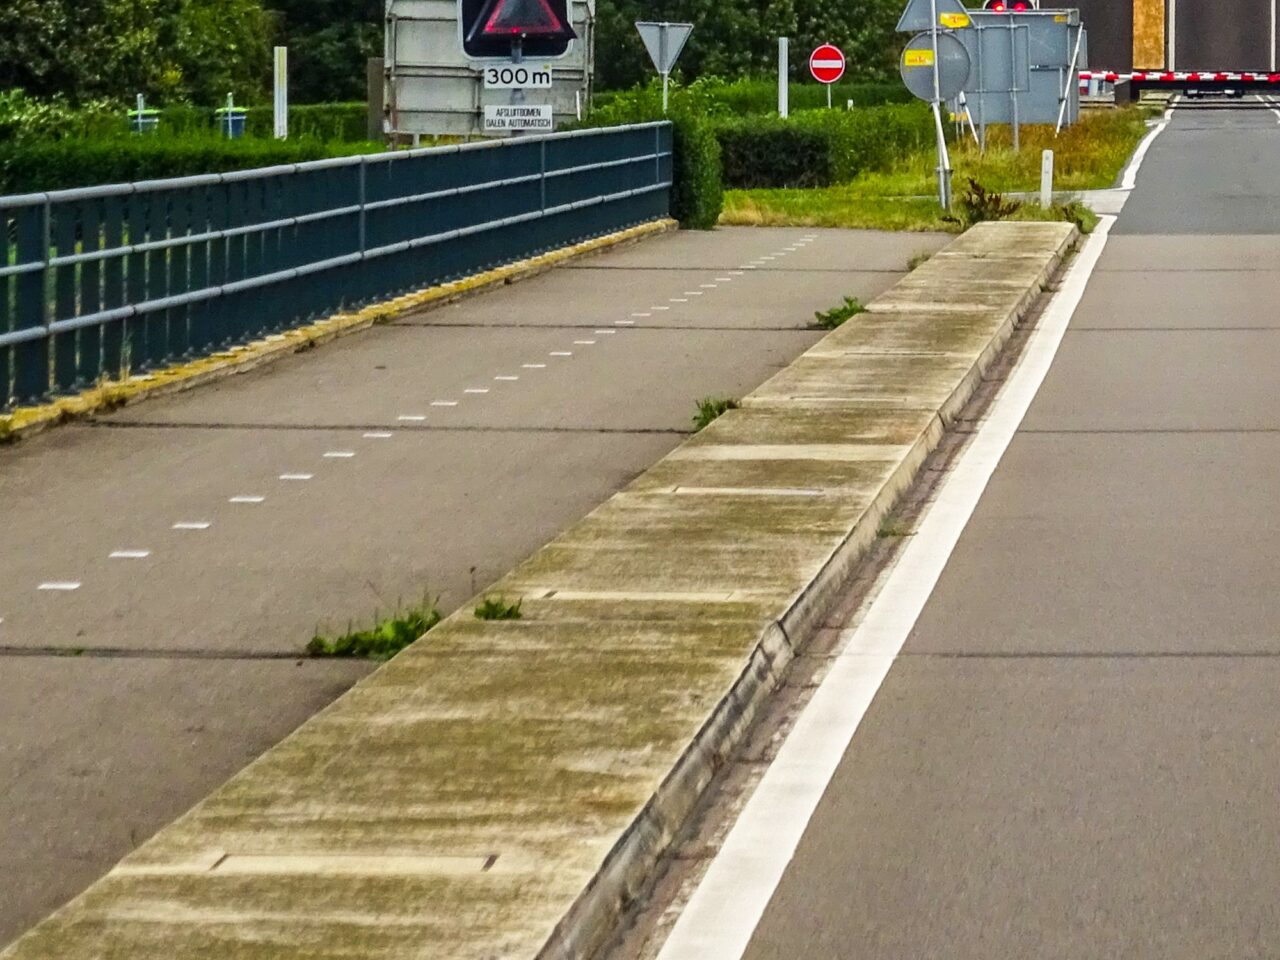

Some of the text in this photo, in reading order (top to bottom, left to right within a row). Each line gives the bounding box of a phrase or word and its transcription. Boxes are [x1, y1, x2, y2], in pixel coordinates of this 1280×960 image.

[487, 68, 550, 84] 300 m
[496, 108, 541, 117] AFSLUITBOMEN
[486, 119, 550, 127] DALEN AUTOMATISCH
